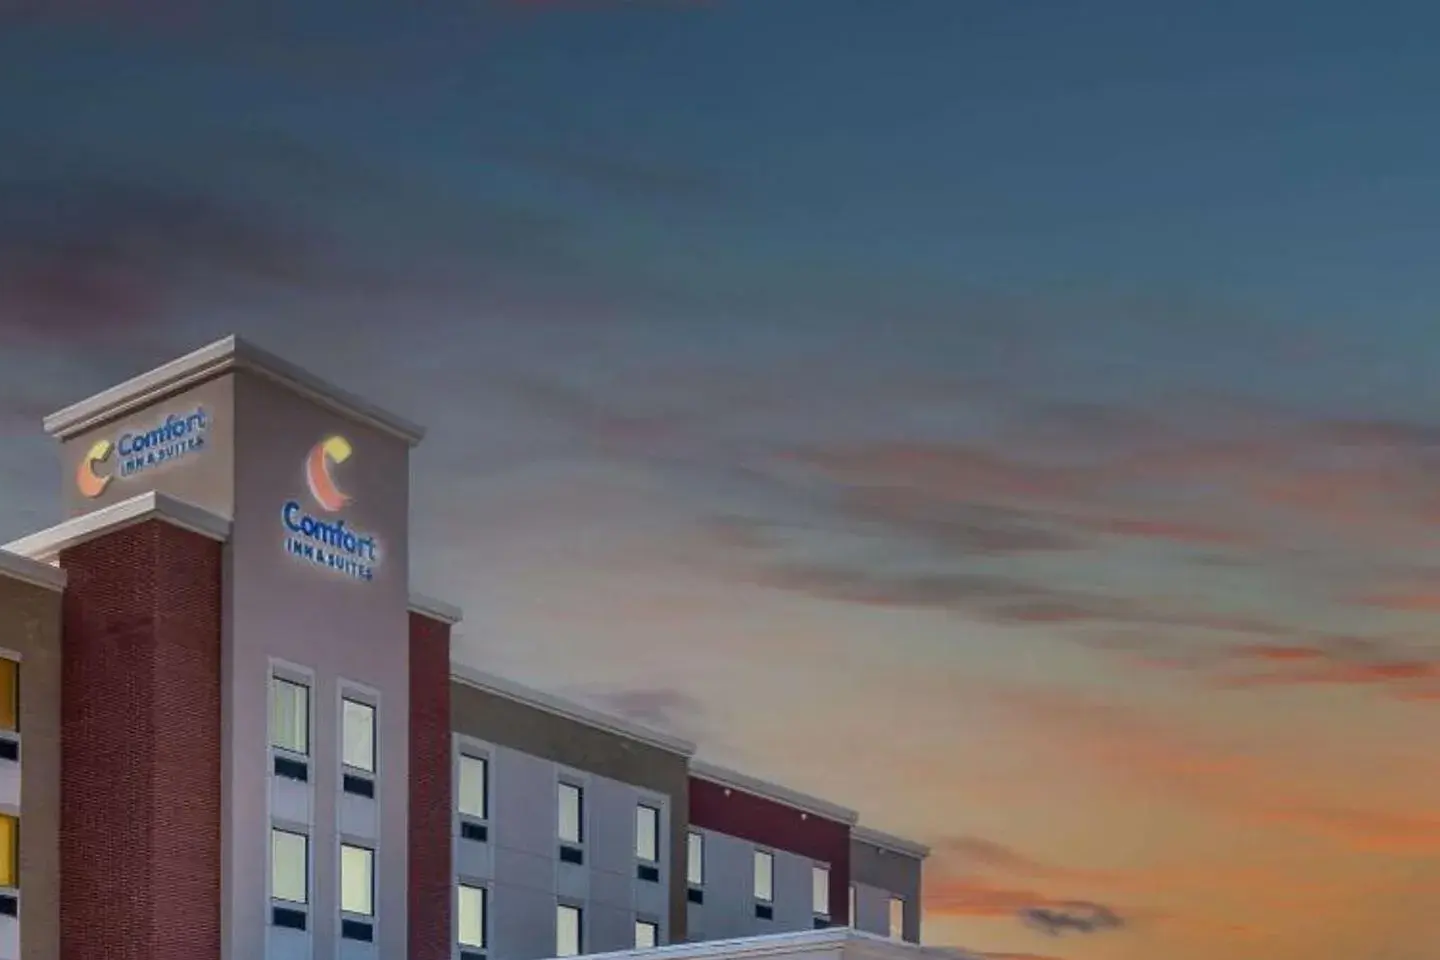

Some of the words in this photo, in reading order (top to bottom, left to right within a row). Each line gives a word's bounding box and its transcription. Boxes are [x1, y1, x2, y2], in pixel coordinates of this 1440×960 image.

[118, 406, 207, 456] Comfort
[158, 436, 204, 462] SUITES
[282, 501, 375, 561] Comfort
[286, 538, 314, 560] INN
[328, 553, 373, 581] SUITES
